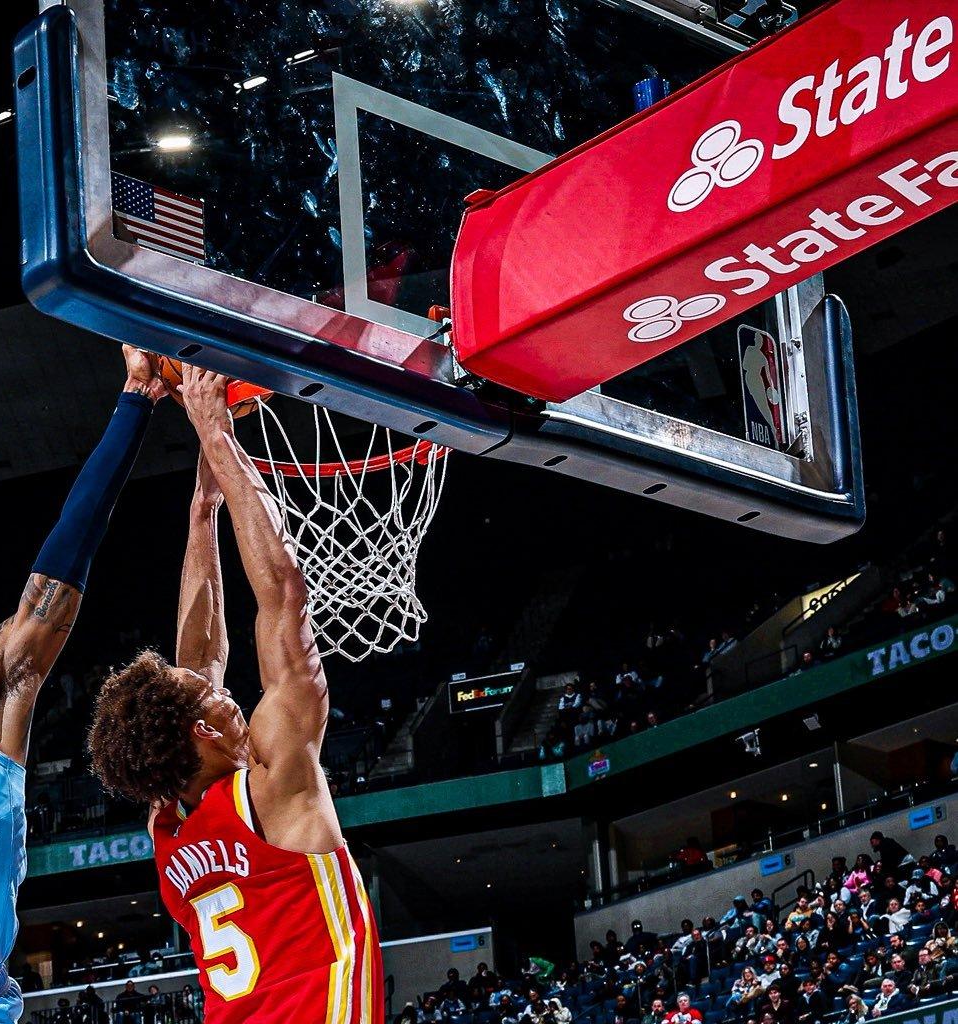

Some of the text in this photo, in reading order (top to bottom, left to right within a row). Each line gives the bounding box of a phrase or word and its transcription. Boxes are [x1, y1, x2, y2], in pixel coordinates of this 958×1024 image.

[772, 16, 953, 160] State
[751, 421, 771, 445] NBA
[867, 624, 954, 676] TACO
[69, 834, 153, 867] TACO
[165, 839, 250, 898] DANIELS
[189, 881, 261, 1002] 5
